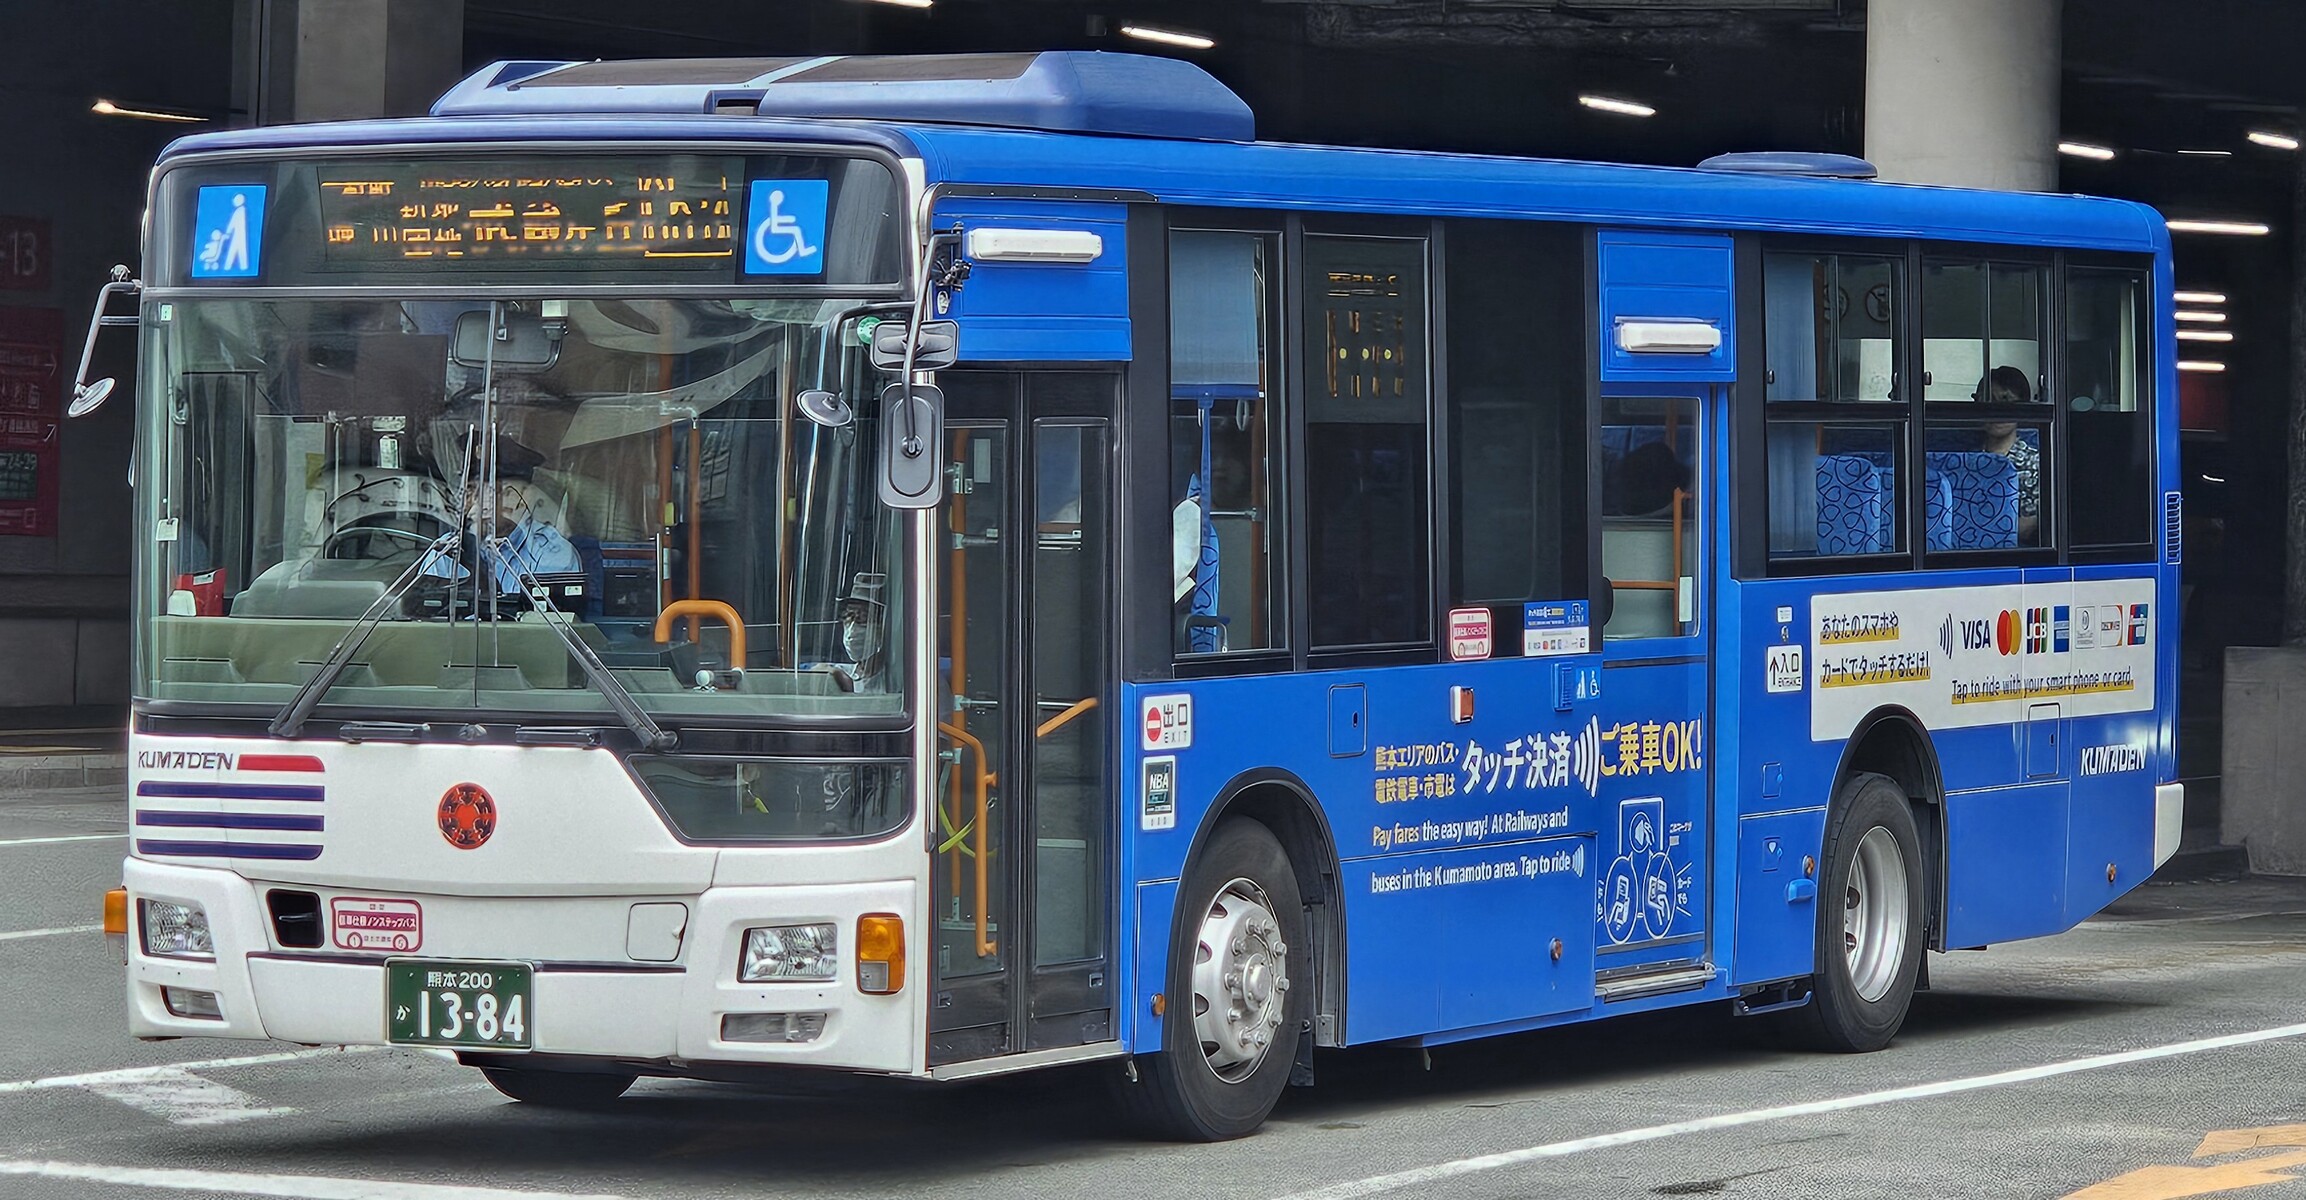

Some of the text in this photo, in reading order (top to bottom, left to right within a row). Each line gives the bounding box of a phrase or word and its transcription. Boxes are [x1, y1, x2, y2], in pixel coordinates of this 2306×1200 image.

[1822, 611, 1899, 641] あなたのスマホや
[1960, 619, 1991, 649] VISA
[2026, 622, 2048, 640] JCB
[1780, 653, 1800, 674] 入口
[1952, 679, 1968, 703] Tap
[1970, 677, 1980, 698] to
[1982, 675, 2000, 696] ride
[2002, 673, 2021, 695] with
[2023, 676, 2044, 698] your
[1163, 703, 1188, 728] 出口
[1164, 730, 1188, 744] EXIT
[138, 750, 234, 770] KUMADEN
[1461, 719, 1702, 795] タッチ決済 ご乗車OK!
[2081, 744, 2148, 777] KUMADEN
[1149, 772, 1169, 790] NBA
[1373, 805, 1569, 852] Pay fares the easy way! At Railways and
[1371, 850, 1571, 894] buses in the Kumamoto area. Tap to ride
[339, 913, 416, 929] 仕ノンステップバス
[396, 990, 525, 1042] か 13-84
